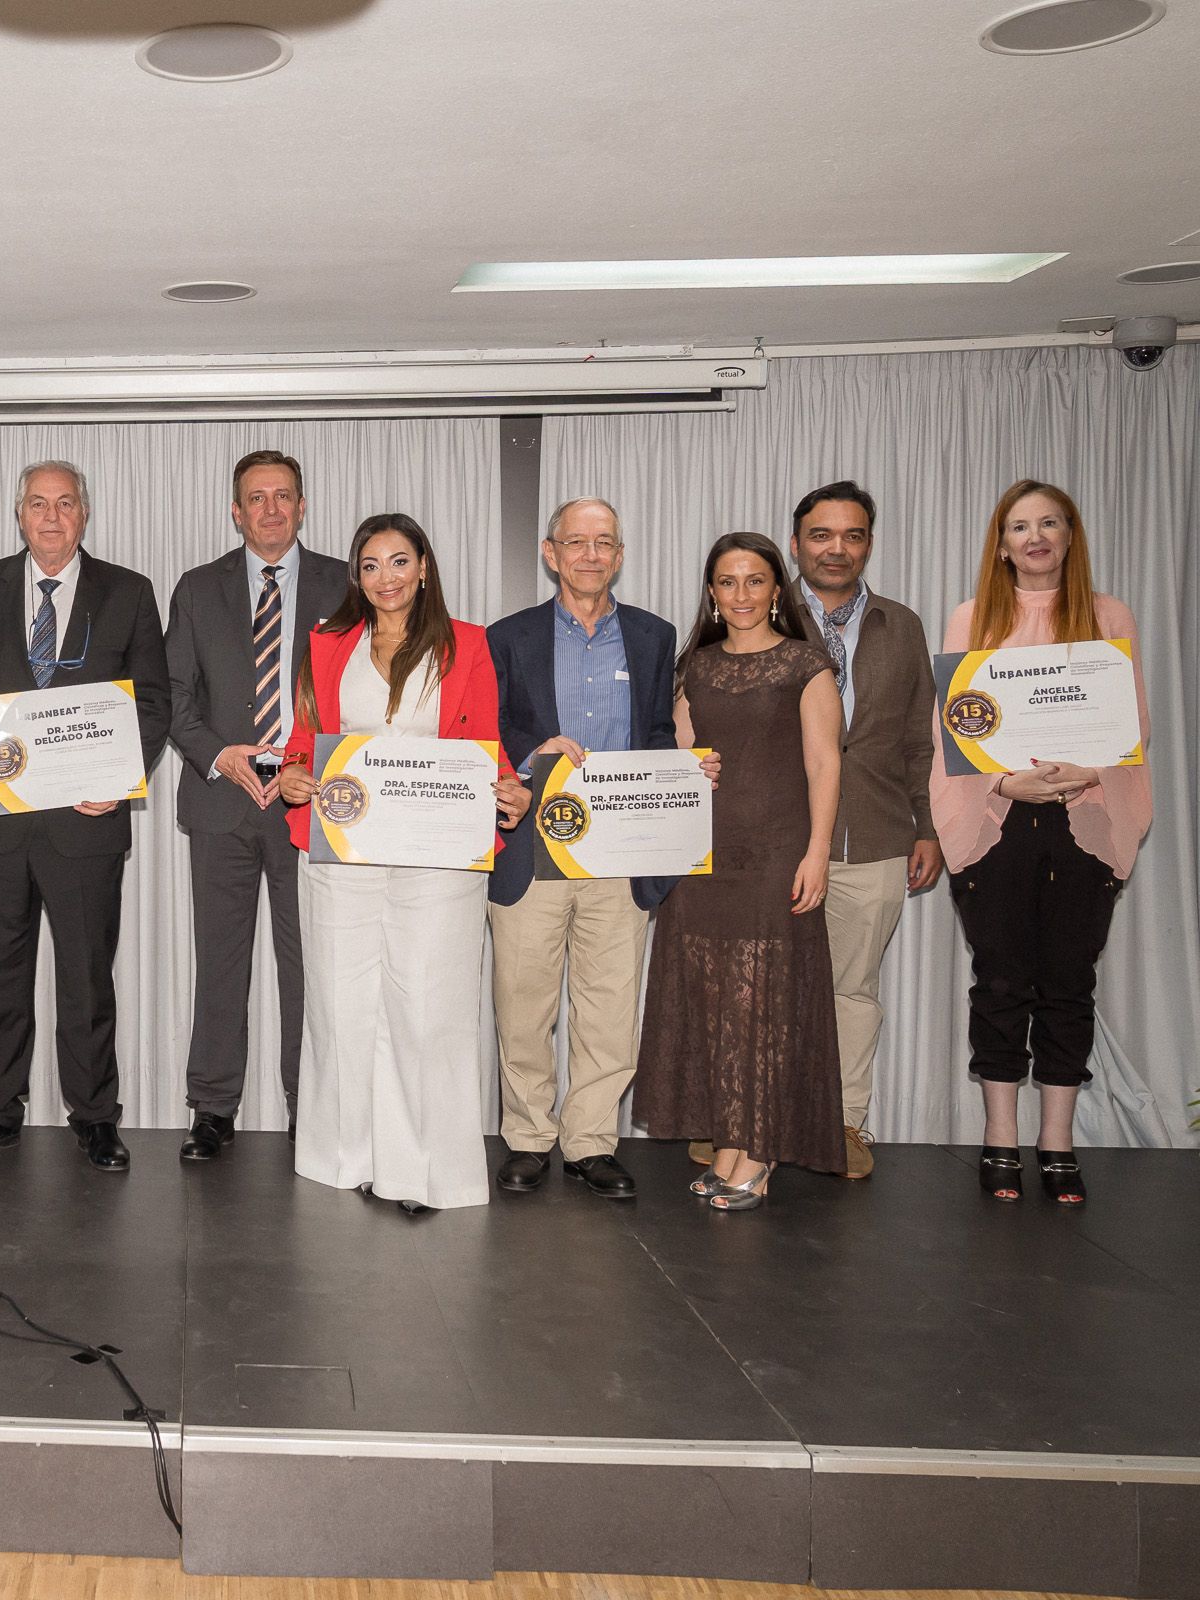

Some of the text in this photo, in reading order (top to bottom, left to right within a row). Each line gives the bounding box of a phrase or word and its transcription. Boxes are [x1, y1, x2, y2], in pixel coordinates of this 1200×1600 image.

[989, 665, 1067, 680] URBANBEAT
[1033, 685, 1081, 696] ÁNGELES
[1029, 694, 1088, 705] GUTIÉRREZ
[960, 705, 982, 718] 15
[47, 722, 97, 735] DR. JESÚS
[35, 729, 114, 746] DELGADO ABOY
[365, 750, 436, 769] URBANBEAT
[583, 768, 652, 784] URBANBEAT
[384, 780, 470, 791] DRA. ESPERANZA
[331, 789, 351, 803] 15
[380, 788, 476, 800] GARCÍA FULGENCIO
[590, 792, 699, 803] DR. FRANCISCO JAVIER
[592, 801, 660, 811] NÚÑEZ-COBOS
[663, 801, 700, 809] ECHART
[553, 807, 572, 820] 15
